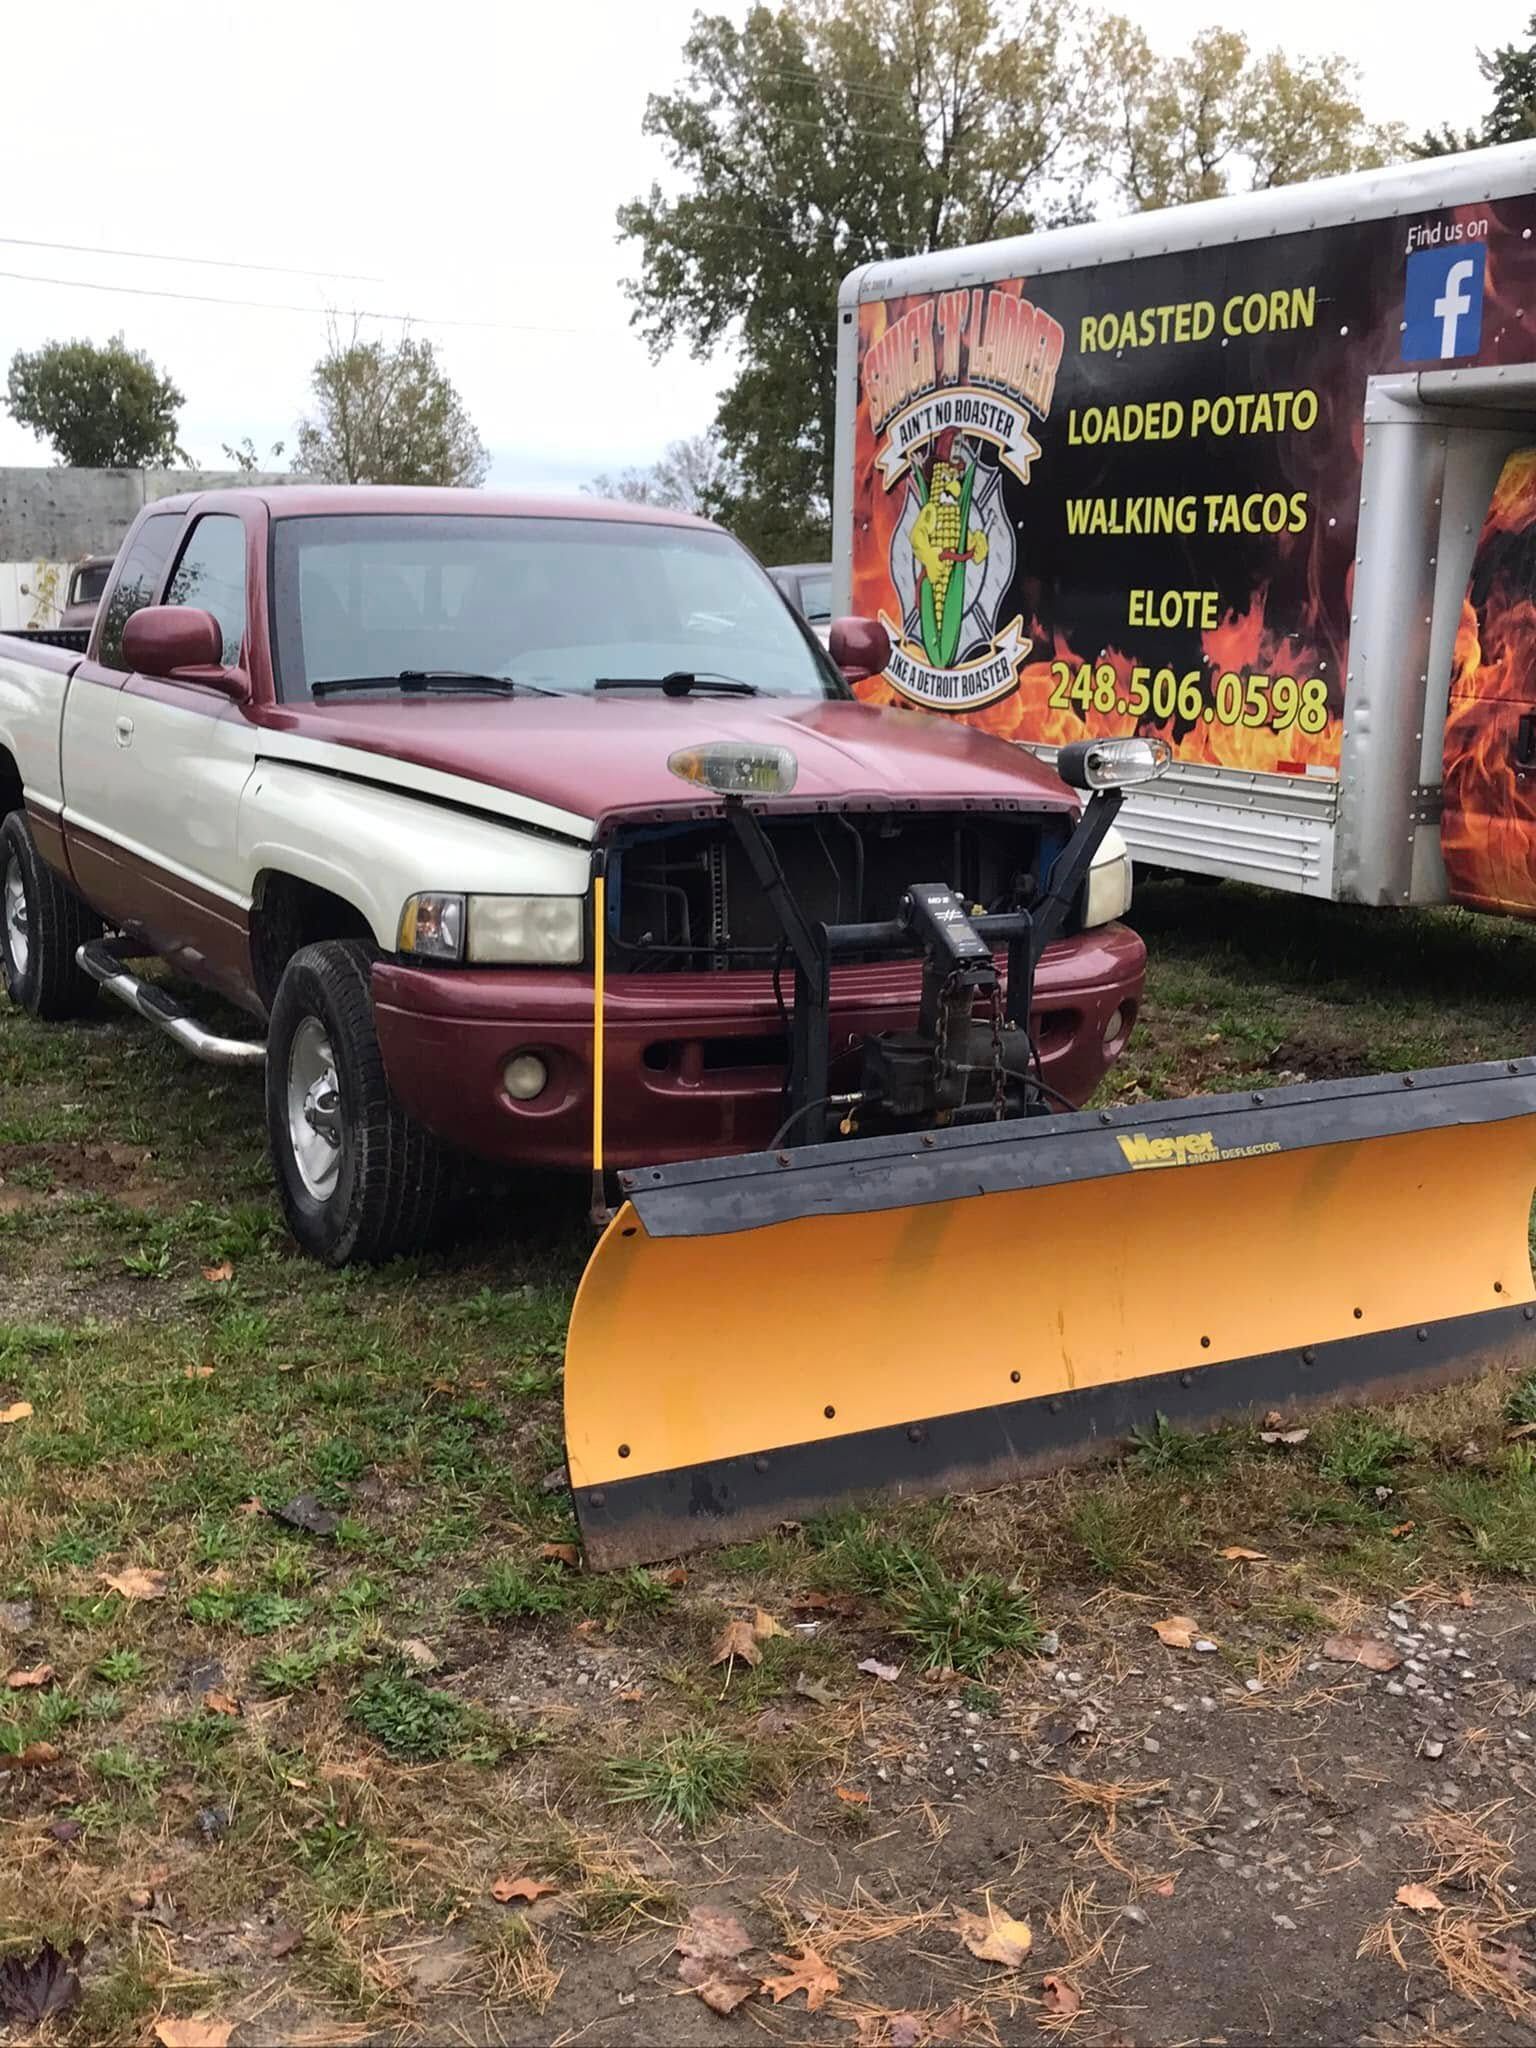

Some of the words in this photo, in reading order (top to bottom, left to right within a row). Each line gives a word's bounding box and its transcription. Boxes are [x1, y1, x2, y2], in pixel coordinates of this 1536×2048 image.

[1407, 221, 1441, 247] Find
[1444, 222, 1463, 241] us
[1466, 219, 1488, 237] on
[1080, 300, 1216, 354] ROASTED
[1222, 286, 1316, 337] CORN
[967, 289, 1065, 423] LADDER
[899, 406, 932, 447] AIN'T
[935, 402, 950, 423] NO
[954, 399, 1015, 439] ROASTER
[1068, 401, 1184, 445] LOADED
[1191, 389, 1318, 437] POTATO
[1066, 496, 1197, 535] WALKING
[1203, 492, 1308, 534] TACOS
[1128, 589, 1219, 629] ELOTE
[888, 654, 909, 682] IKE
[908, 665, 916, 688] A
[917, 669, 959, 698] DETROIT
[961, 656, 1011, 697] ROASTER
[1050, 661, 1328, 733] 248.506.0598
[1221, 1142, 1281, 1159] DEFLECTOR
